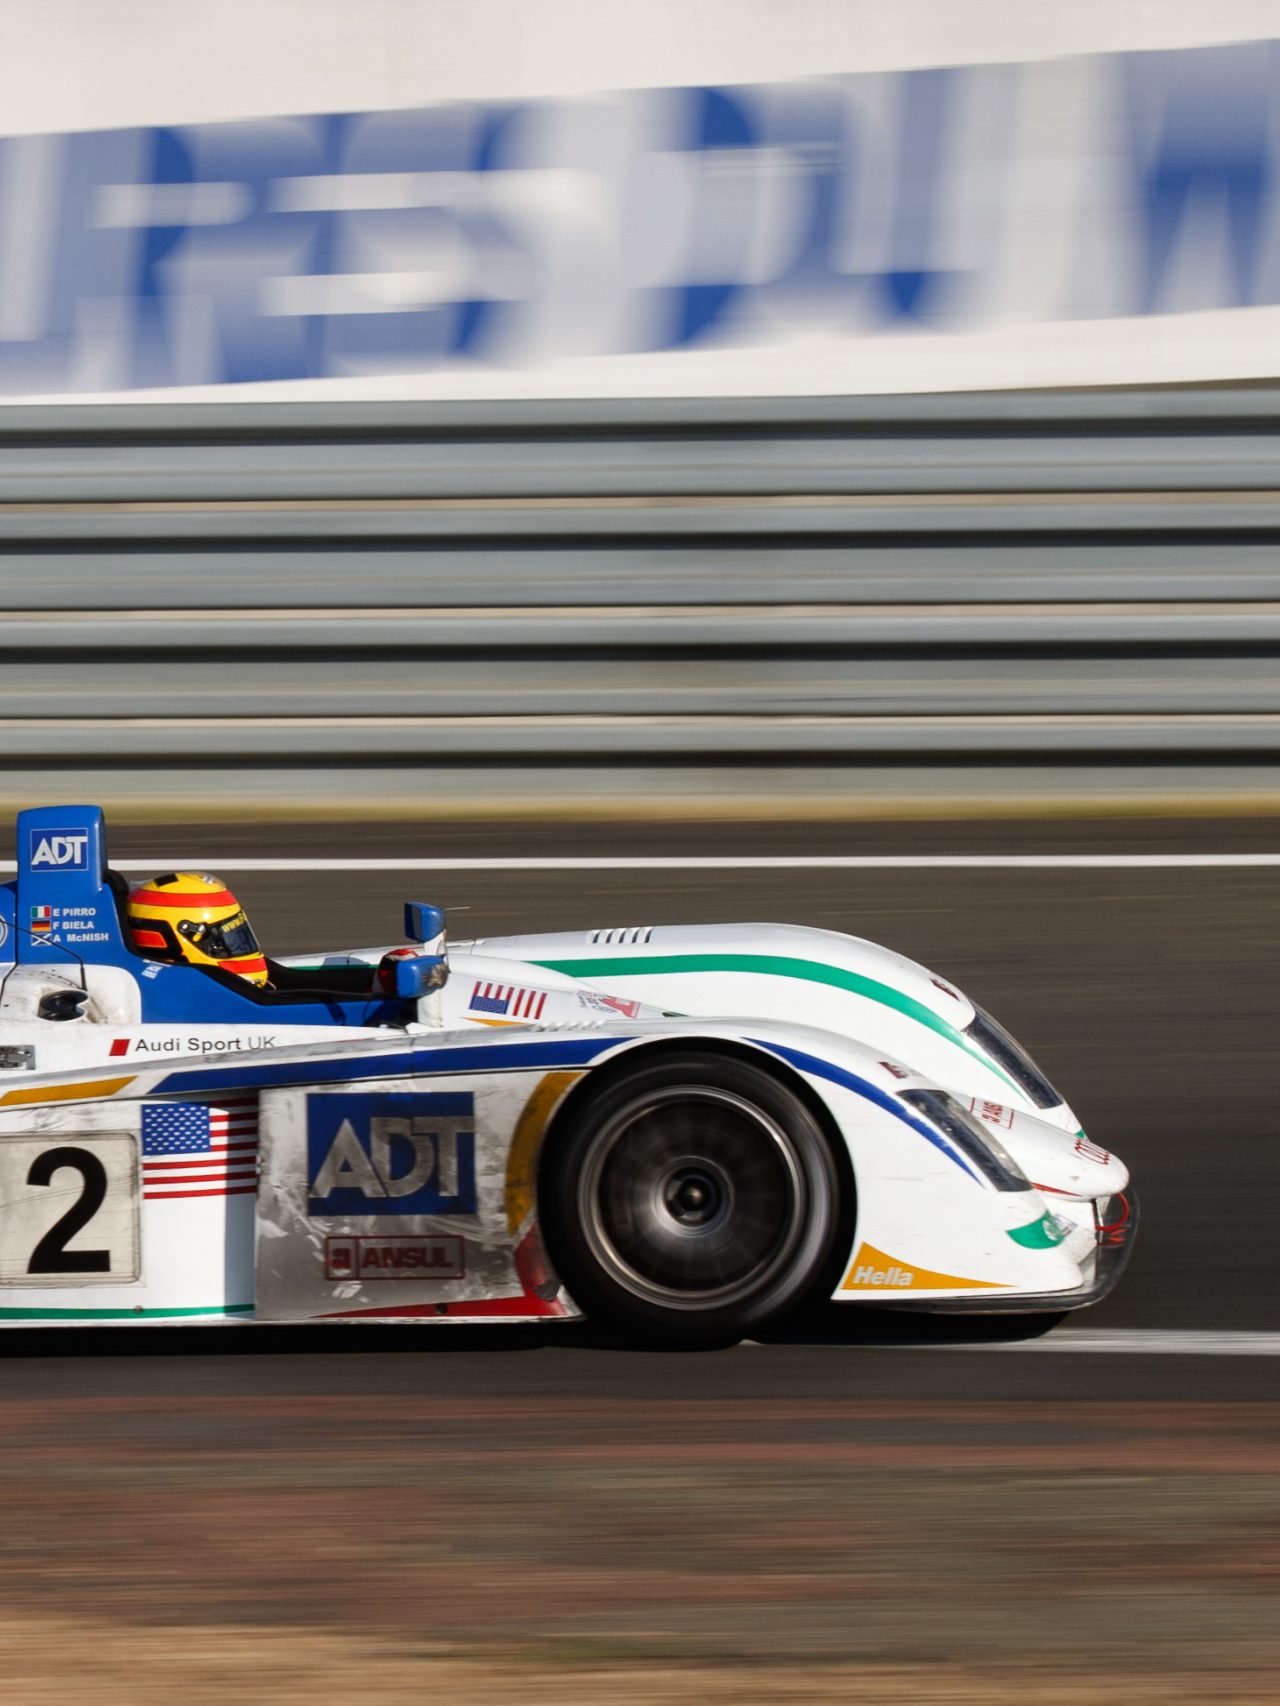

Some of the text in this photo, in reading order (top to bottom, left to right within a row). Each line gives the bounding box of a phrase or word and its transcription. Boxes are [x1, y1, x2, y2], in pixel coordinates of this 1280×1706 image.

[31, 836, 88, 865] ADT
[53, 908, 96, 917] E PIRRO
[53, 921, 95, 930] F BIELA
[53, 933, 109, 943] A McNISH
[135, 1036, 276, 1054] Audi Sport UK
[309, 1116, 474, 1199] ADT
[27, 1146, 111, 1275] 2
[361, 1247, 454, 1269] ANSUL
[852, 1265, 914, 1286] Hella
